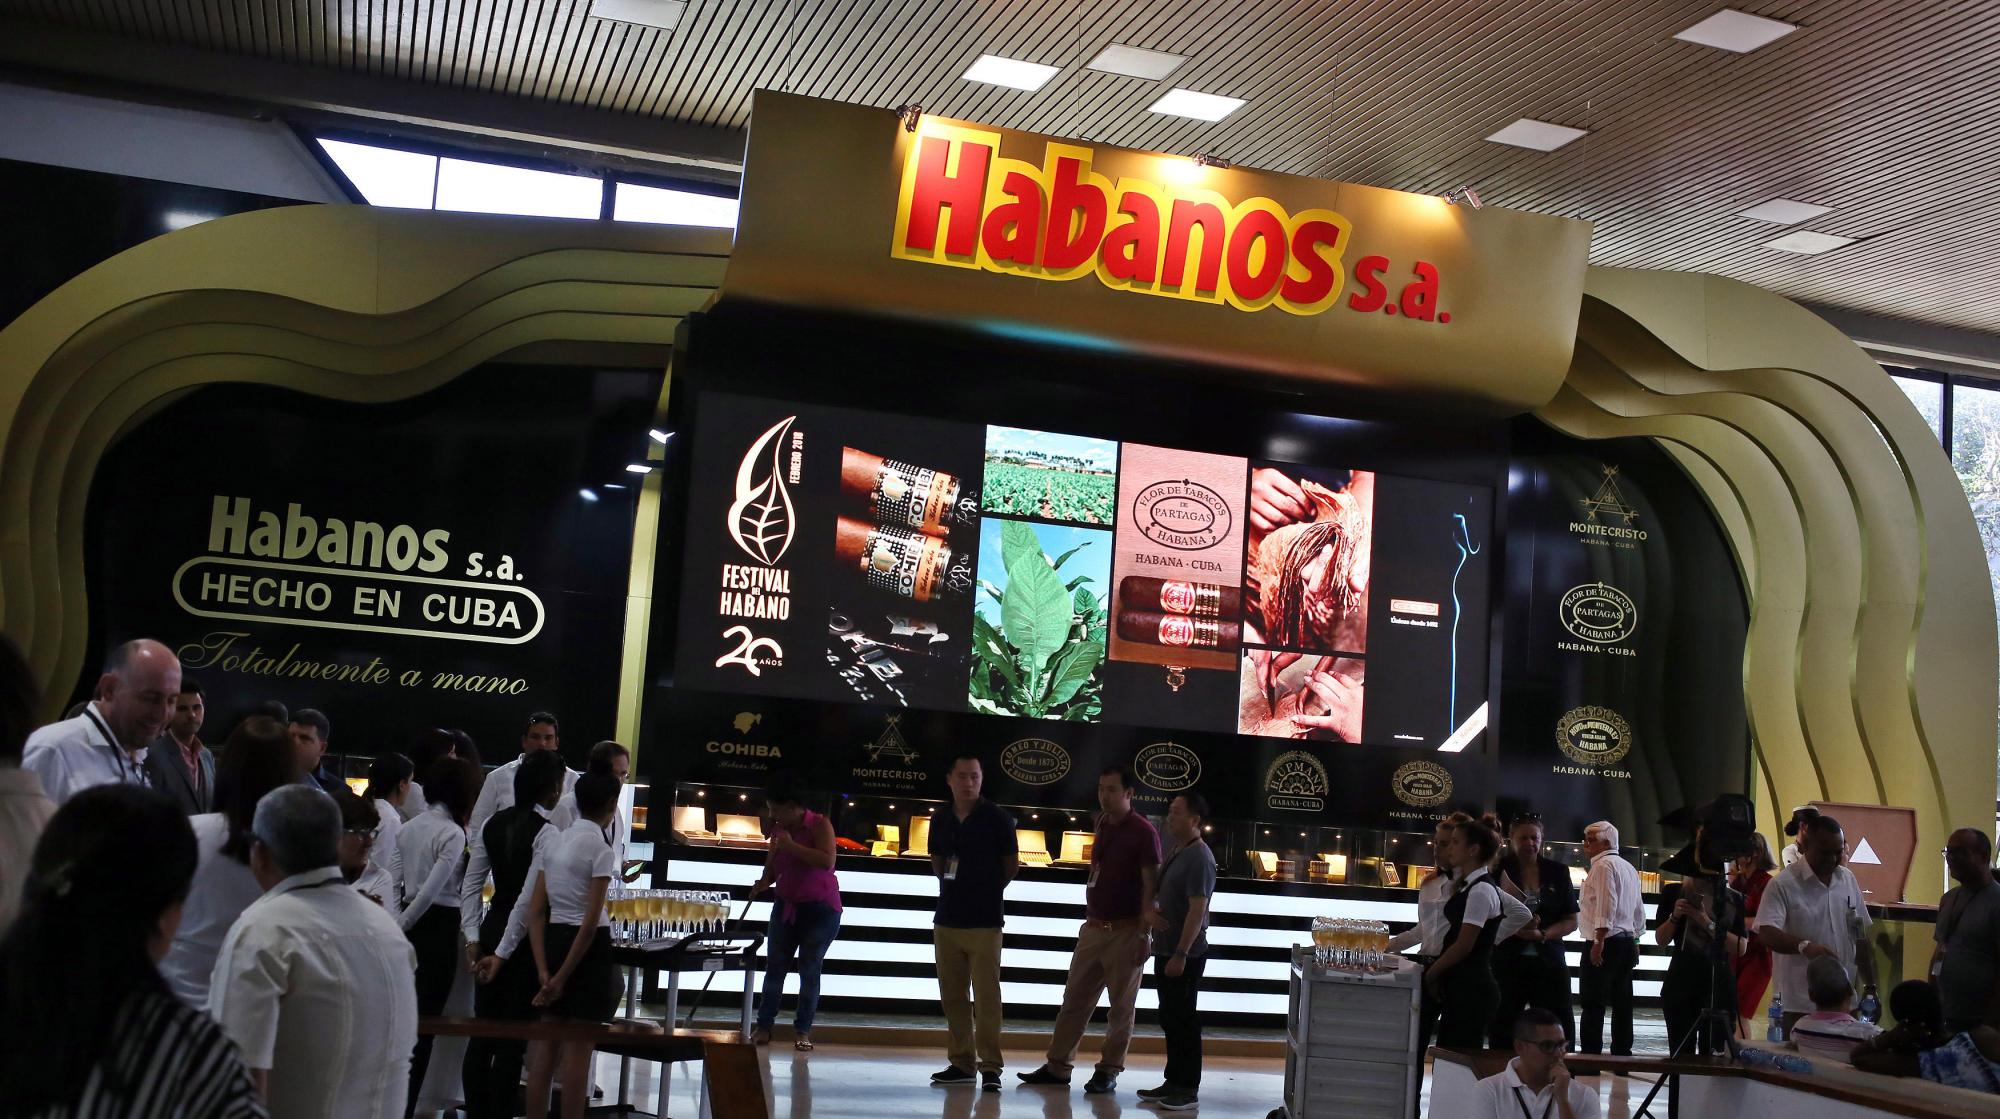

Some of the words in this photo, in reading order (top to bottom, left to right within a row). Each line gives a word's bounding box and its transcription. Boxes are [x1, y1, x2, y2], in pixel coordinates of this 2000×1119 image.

[903, 134, 1342, 305] Habanos
[1350, 255, 1452, 324] s.a.
[789, 451, 802, 484] FEBRERO
[1139, 487, 1165, 507] FLOR
[1167, 486, 1181, 495] DE
[1184, 486, 1226, 516] TABACOS
[1155, 507, 1212, 522] PARTAGAS
[208, 495, 450, 573] Habanos
[466, 552, 524, 581] s.a.
[1157, 530, 1207, 546] HABANA
[1569, 522, 1648, 540] MONTECRISTO
[1580, 538, 1610, 547] HABANA
[1615, 542, 1635, 550] CUBA
[900, 536, 925, 595] COHIBA
[1135, 553, 1184, 568] HABANA
[1191, 560, 1223, 572] CUBA
[722, 564, 790, 594] FESTIVAL
[201, 573, 332, 612] HECHO
[354, 587, 401, 618] EN
[423, 593, 522, 630] CUBA
[720, 591, 790, 621] HABANO
[1564, 590, 1585, 608] FLOR
[1586, 588, 1597, 596] DE
[1599, 588, 1633, 614] TABACOS
[1577, 607, 1621, 620] PARTAGAS
[1579, 626, 1618, 640] HABANA
[1558, 642, 1600, 653] HABANA
[1608, 647, 1636, 657] CUBA
[178, 631, 392, 685] Totalmente
[400, 669, 423, 688] a
[432, 672, 529, 695] mano
[759, 659, 783, 667] AÑOS
[706, 740, 782, 758] COHIBA
[1579, 740, 1607, 751] HABANA
[1004, 741, 1029, 765] ROMEO
[1033, 741, 1040, 749] Y
[1041, 742, 1068, 769] JULIETA
[1139, 748, 1156, 762] FLOR
[1149, 762, 1188, 771] PARTAGAS
[1553, 766, 1595, 776] HABANA
[1603, 770, 1632, 778] CUBA
[852, 768, 927, 781] MONTECRISTO
[1151, 777, 1184, 788] HABANA
[1411, 787, 1433, 796] HABANA
[1132, 795, 1168, 804] HABANA
[1389, 811, 1423, 820] HABANA
[1429, 813, 1451, 821] CUB
